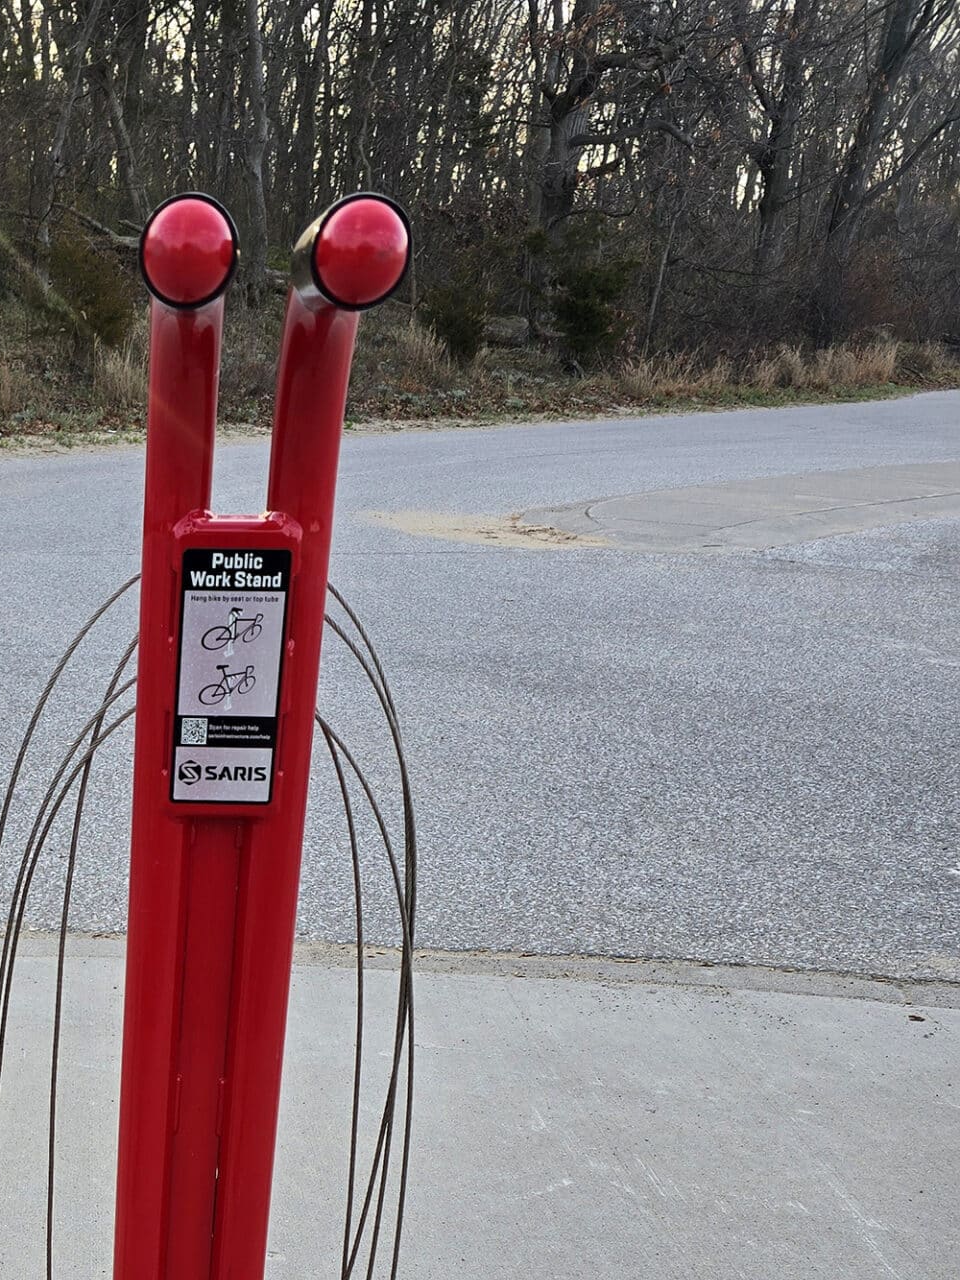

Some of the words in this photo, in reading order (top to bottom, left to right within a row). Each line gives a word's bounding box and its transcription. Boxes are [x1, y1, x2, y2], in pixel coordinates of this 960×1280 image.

[212, 553, 263, 569] Public
[190, 571, 231, 587] Work
[234, 571, 282, 588] Stand
[191, 595, 207, 603] Hang
[222, 595, 229, 603] by
[205, 766, 267, 781] SARIS
